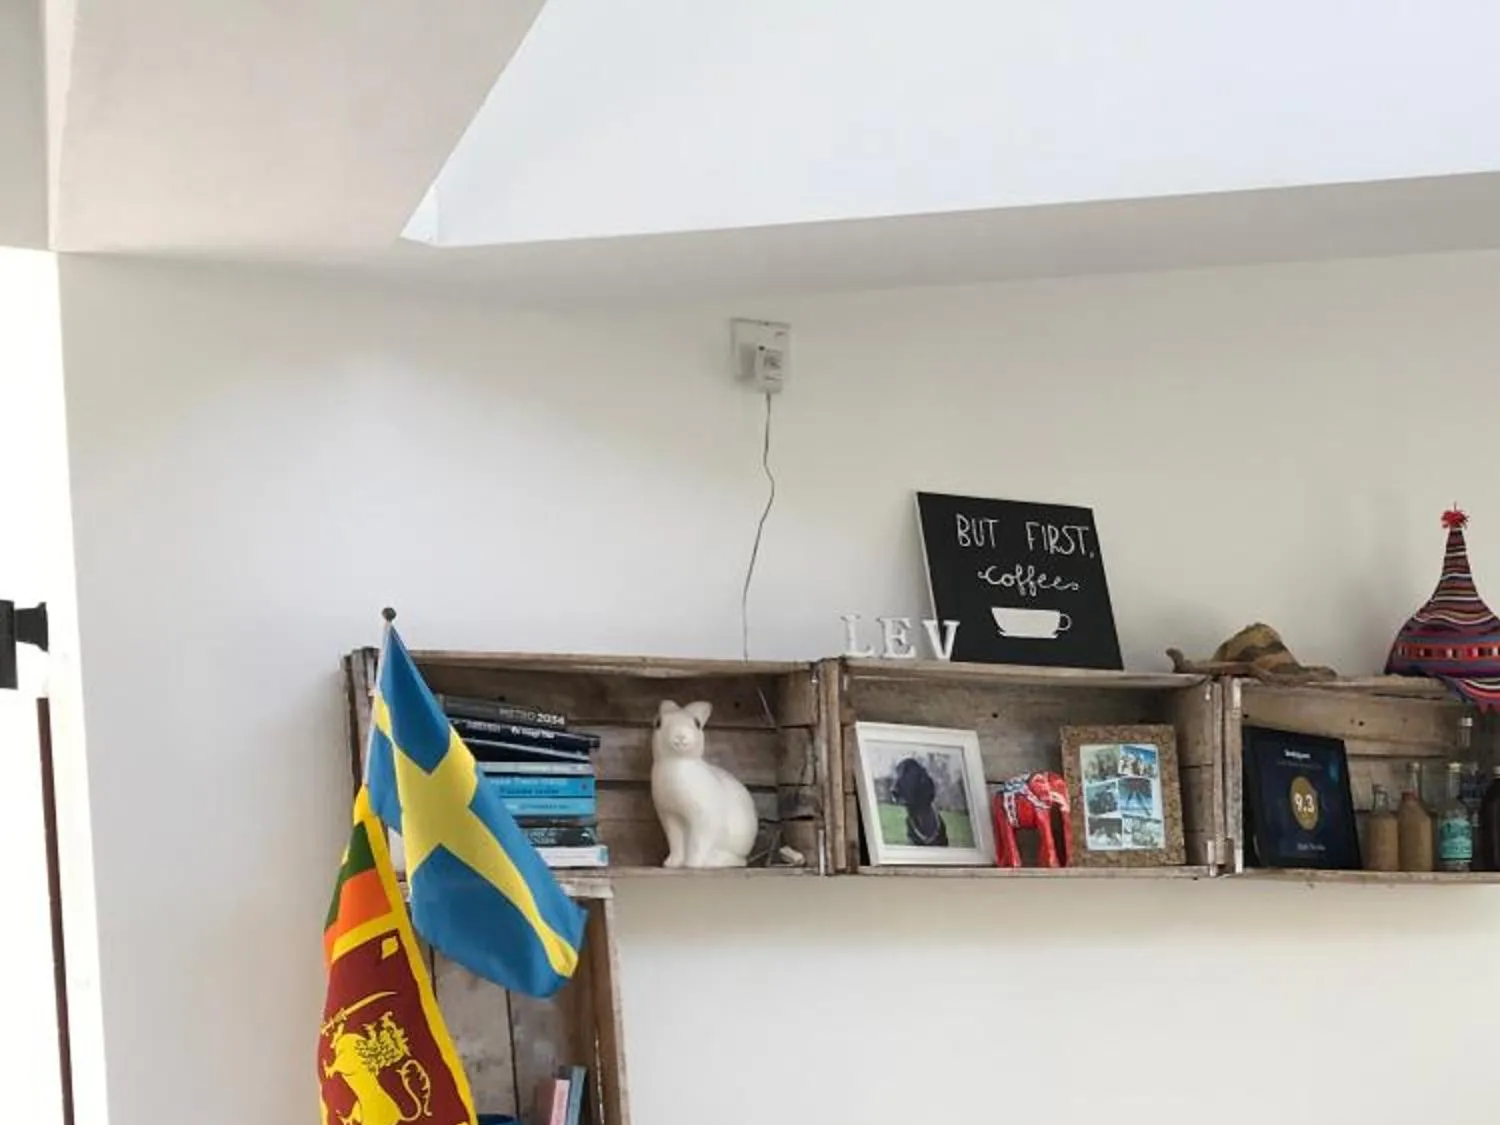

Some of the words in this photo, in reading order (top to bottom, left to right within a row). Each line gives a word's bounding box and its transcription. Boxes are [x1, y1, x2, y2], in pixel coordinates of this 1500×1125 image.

[956, 513, 999, 548] BUT
[977, 563, 1079, 597] coffee
[1294, 791, 1316, 814] 9.3
